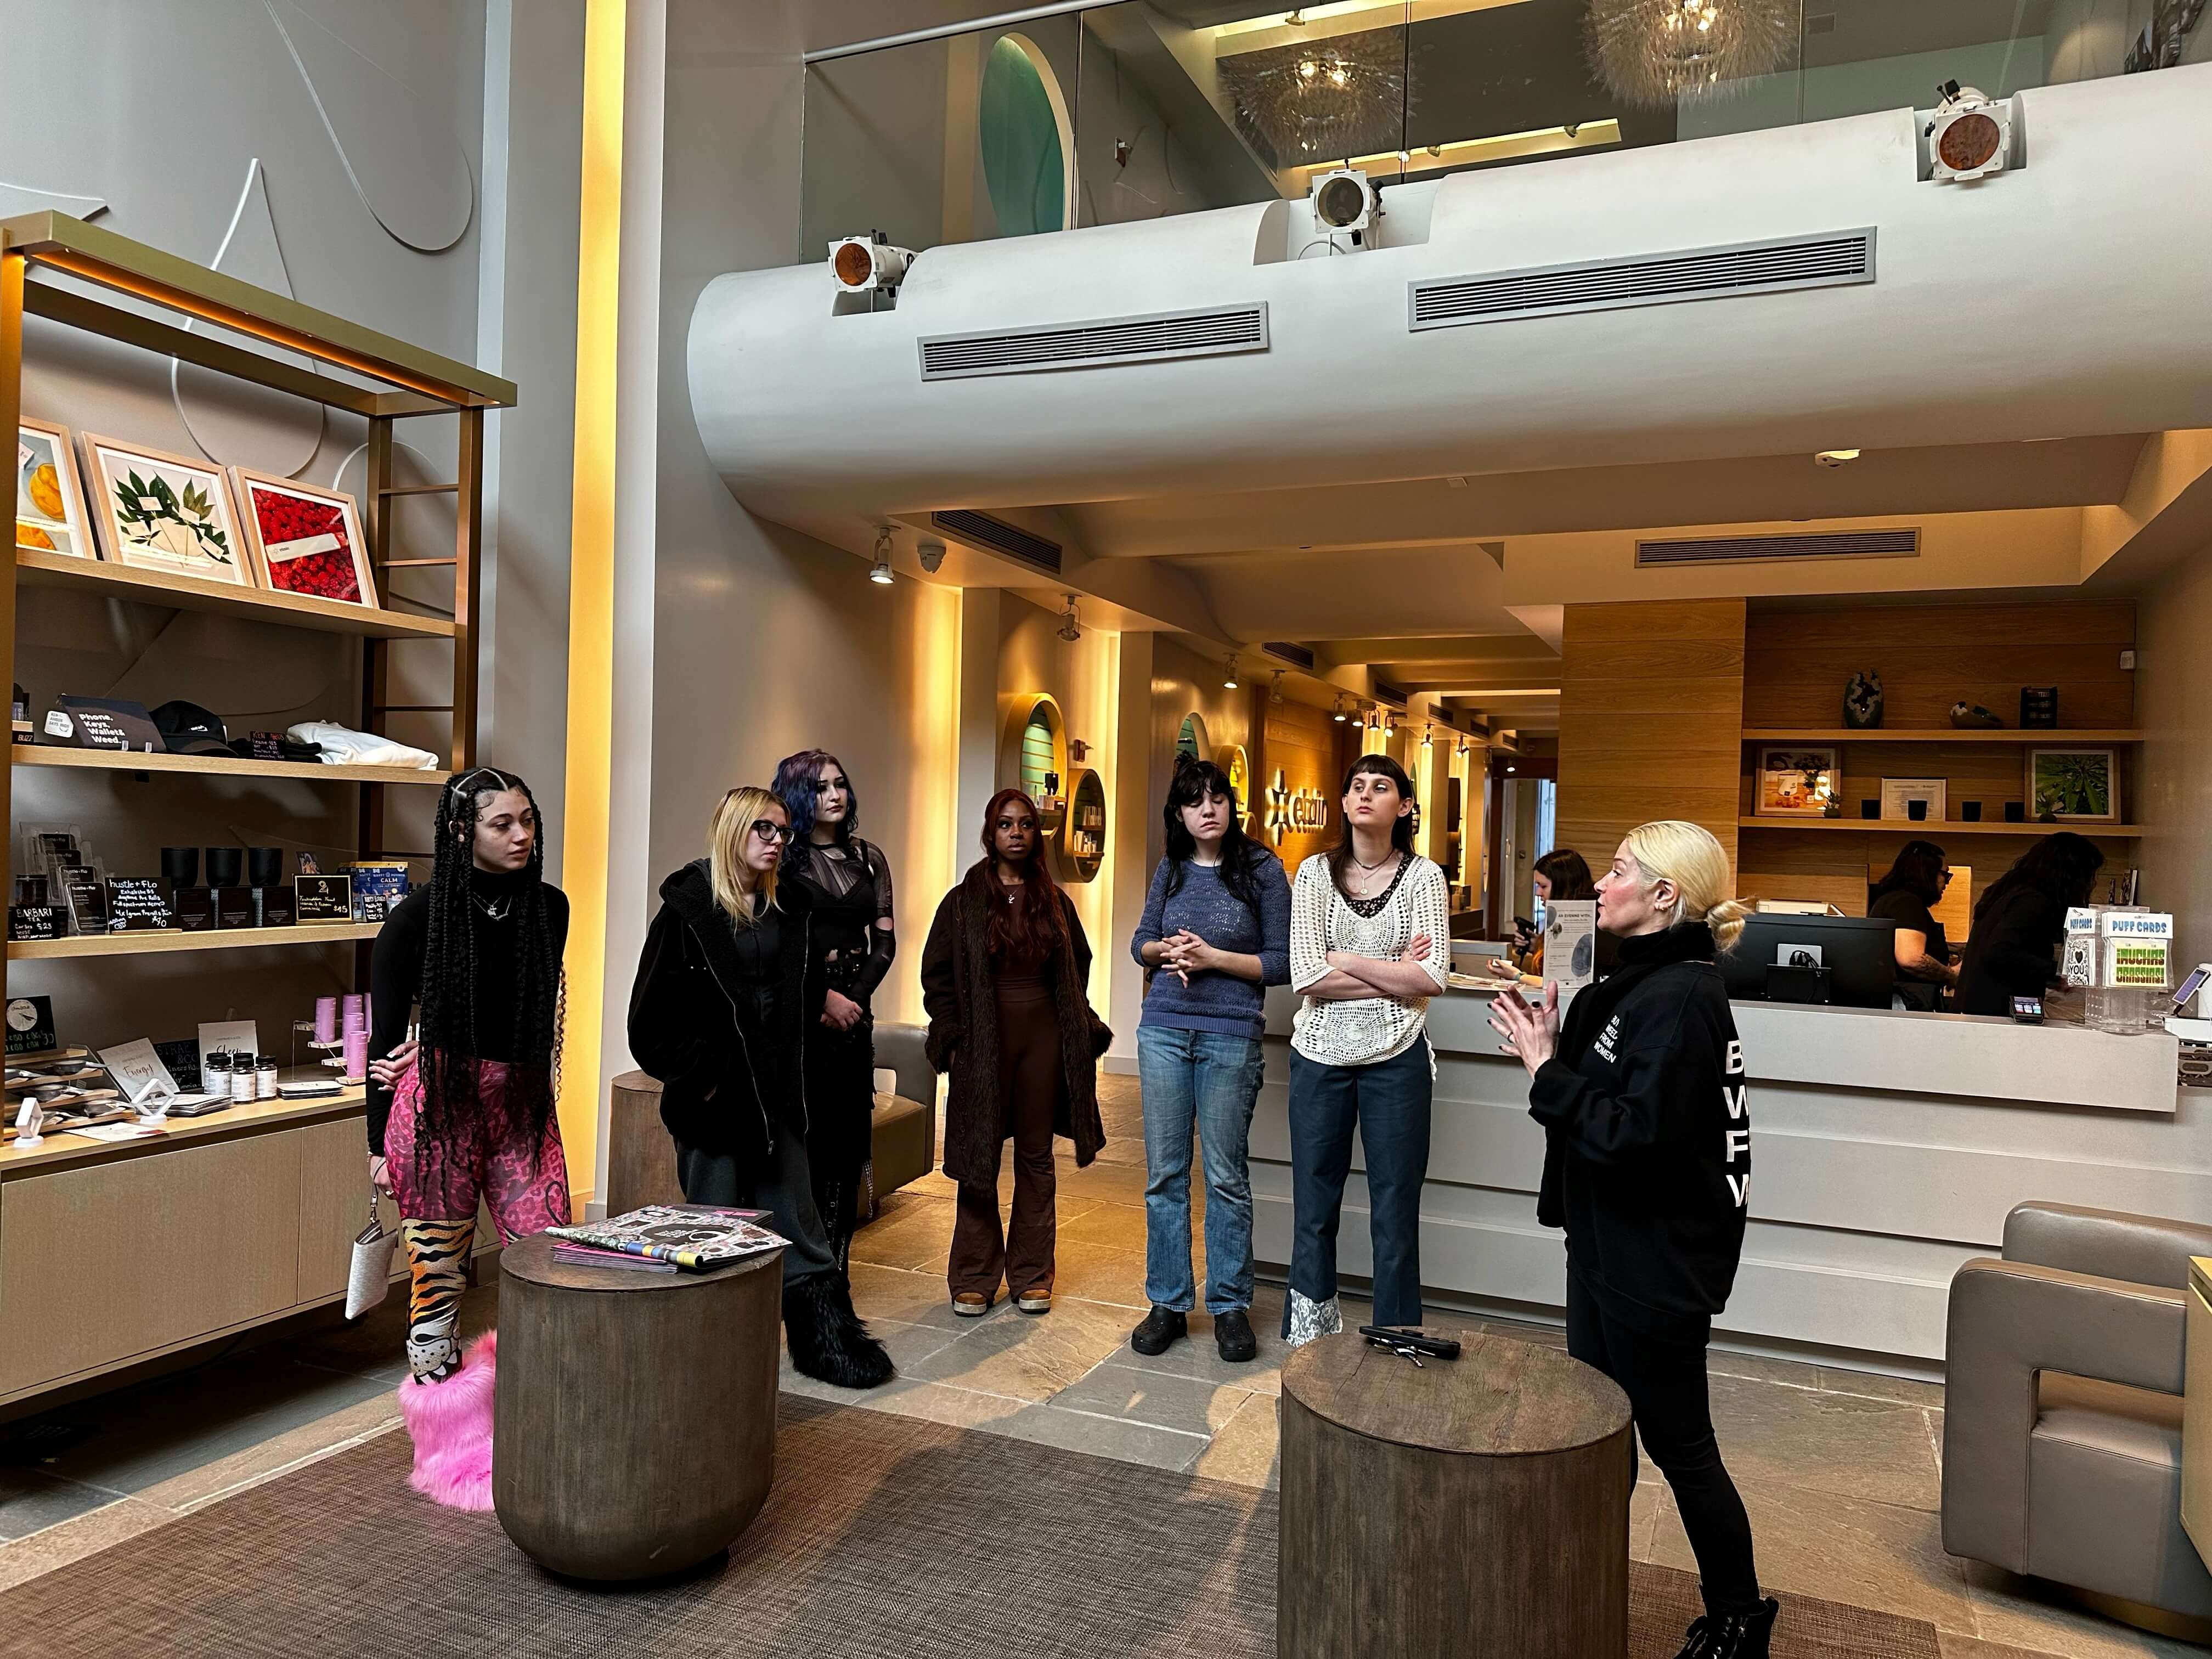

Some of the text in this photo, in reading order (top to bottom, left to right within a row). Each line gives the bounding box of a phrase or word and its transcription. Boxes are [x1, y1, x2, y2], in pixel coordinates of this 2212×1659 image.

[16, 907, 53, 918] BARBARI
[2112, 921, 2166, 933] PUFF CARDS
[2069, 965, 2084, 974] YOU
[1599, 1032, 1615, 1049] FROM
[1594, 1040, 1617, 1063] WOMEN
[122, 1063, 154, 1078] Energy
